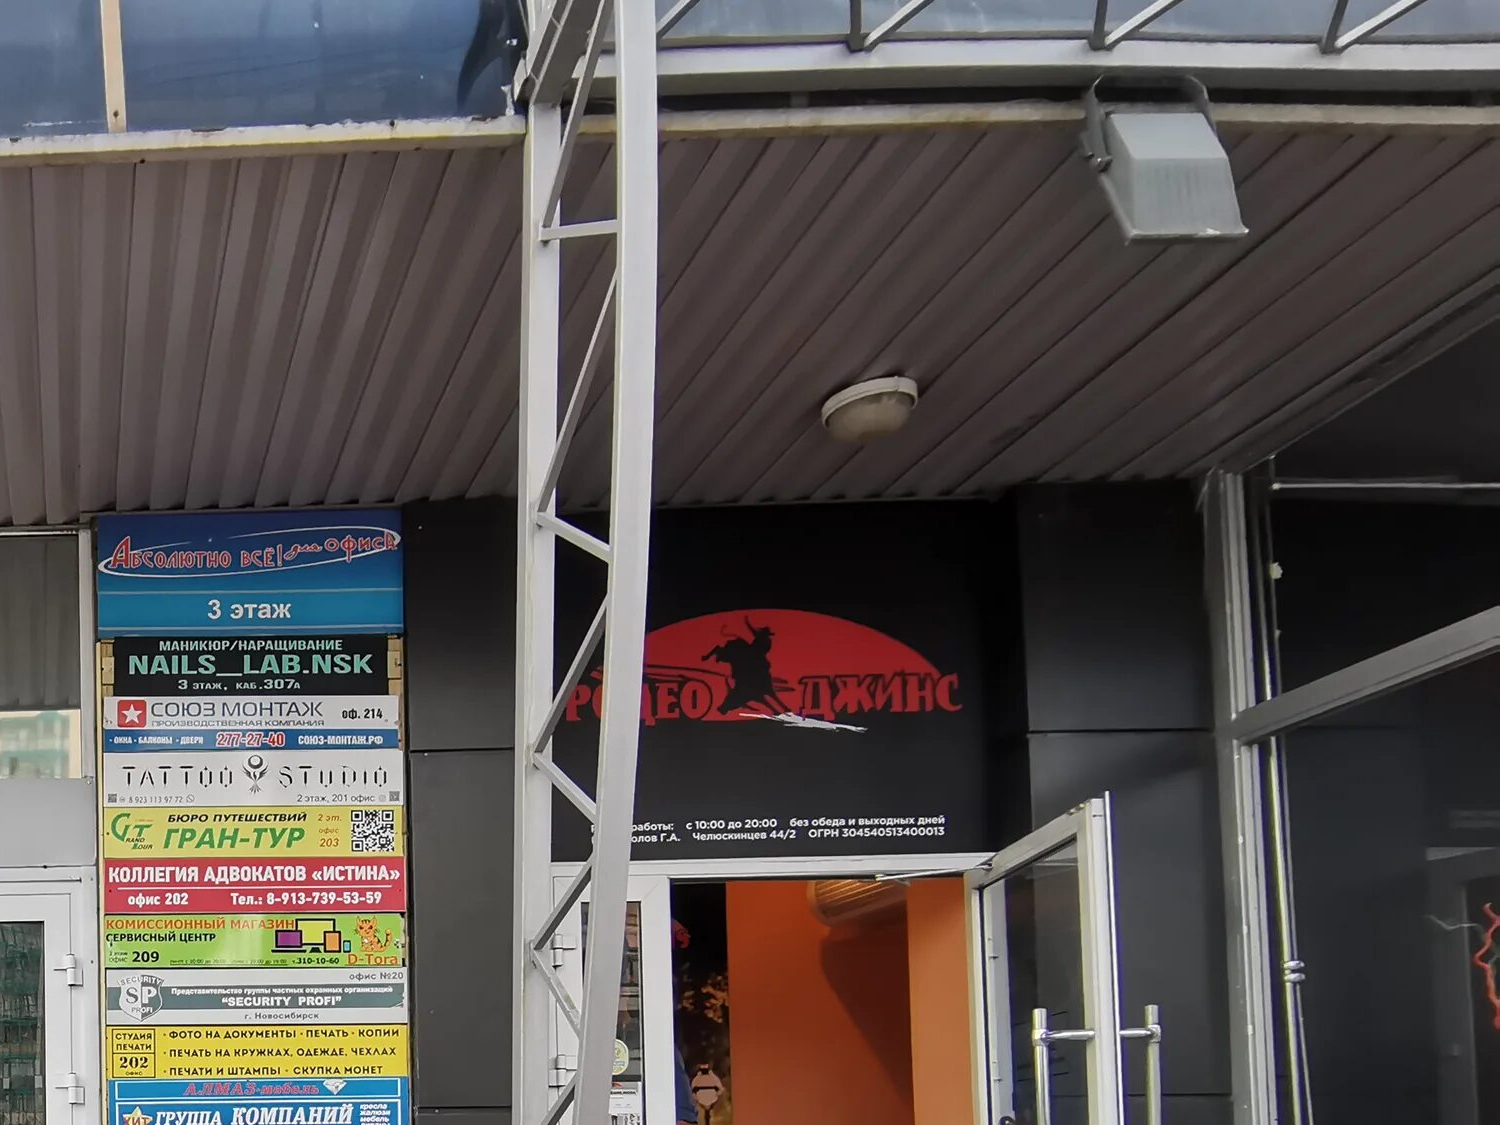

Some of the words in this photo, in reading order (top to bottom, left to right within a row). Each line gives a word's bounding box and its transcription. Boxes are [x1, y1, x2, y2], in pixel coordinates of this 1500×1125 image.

[207, 599, 222, 620] 3
[230, 601, 292, 619] этаж
[159, 639, 343, 653] МАНИКЮР/НАРАЩИВАНИЕ
[177, 679, 188, 690] 3
[798, 671, 964, 721] ДЖИНС
[151, 702, 217, 718] СОЮЗ
[221, 701, 324, 718] МОНТАЖ
[341, 709, 361, 721] оф.
[363, 708, 383, 720] 214
[151, 719, 263, 728] ПРОИЗВОДСТВЕННАЯ
[264, 719, 325, 727] КОМПАНИЯ
[216, 732, 286, 748] 277-27-40
[297, 735, 384, 746] СОЮЗ-МОНТАЖ.РФ
[121, 765, 234, 789] TATTOO
[304, 795, 330, 804] этаж,
[332, 794, 348, 802] 201
[350, 794, 376, 803] офис
[167, 813, 209, 823] БЮРО
[213, 811, 308, 822] ПУТЕШЕСТВИЙ
[695, 820, 724, 830] 10:00
[727, 820, 744, 831] до
[745, 818, 778, 829] 20:00
[789, 816, 809, 827] без
[811, 816, 846, 828] обеда
[858, 816, 916, 827] выходных
[917, 815, 945, 826] дней
[163, 827, 306, 850] ГРАН-ТУР
[660, 833, 682, 843] Г.А.
[692, 832, 768, 843] Челюскинцев
[769, 829, 797, 841] 44/2
[808, 828, 840, 839] ОГРН
[841, 826, 946, 838] 304540513400013
[319, 838, 340, 848] 203
[108, 866, 199, 883] КОЛЛЕГИЯ
[203, 865, 307, 884] АДВОКАТОВ
[311, 864, 401, 881] «ИСТИНА»
[127, 893, 161, 907] офис
[165, 893, 189, 905] 202
[230, 892, 263, 905] Тел.:
[266, 891, 383, 905] 8-913-739-53-59
[105, 917, 226, 930] КОМИССИОННЫЙ
[230, 918, 296, 930] МАГАЗИН
[105, 931, 176, 943] СЕРВИСНЫЙ
[179, 933, 217, 944] ЦЕНТР
[131, 950, 160, 963] 209
[347, 953, 398, 966] D-Tora
[349, 972, 377, 981] офис
[125, 986, 158, 1004] SP
[254, 1011, 320, 1021] Новосибирск
[115, 1032, 153, 1042] СТУДИЯ
[169, 1030, 202, 1039] ФОТО
[205, 1029, 221, 1039] НА
[224, 1029, 297, 1040] ДОКУМЕНТЫ
[305, 1028, 349, 1038] ПЕЧАТЬ
[358, 1028, 400, 1037] КОПИИ
[115, 1042, 152, 1051] ПЕЧАТИ
[169, 1048, 212, 1058] ПЕЧАТЬ
[215, 1048, 231, 1057] НА
[234, 1048, 293, 1058] КРУЖКАХ,
[296, 1047, 348, 1057] ОДЕЖДЕ,
[350, 1047, 397, 1056] ЧЕХЛАХ
[118, 1055, 150, 1069] 202
[169, 1067, 211, 1076] ПЕЧАТИ
[215, 1067, 225, 1075] И
[227, 1066, 281, 1075] ШТАМПЫ
[293, 1066, 341, 1075] СКУПКА
[345, 1065, 383, 1074] МОНЕТ
